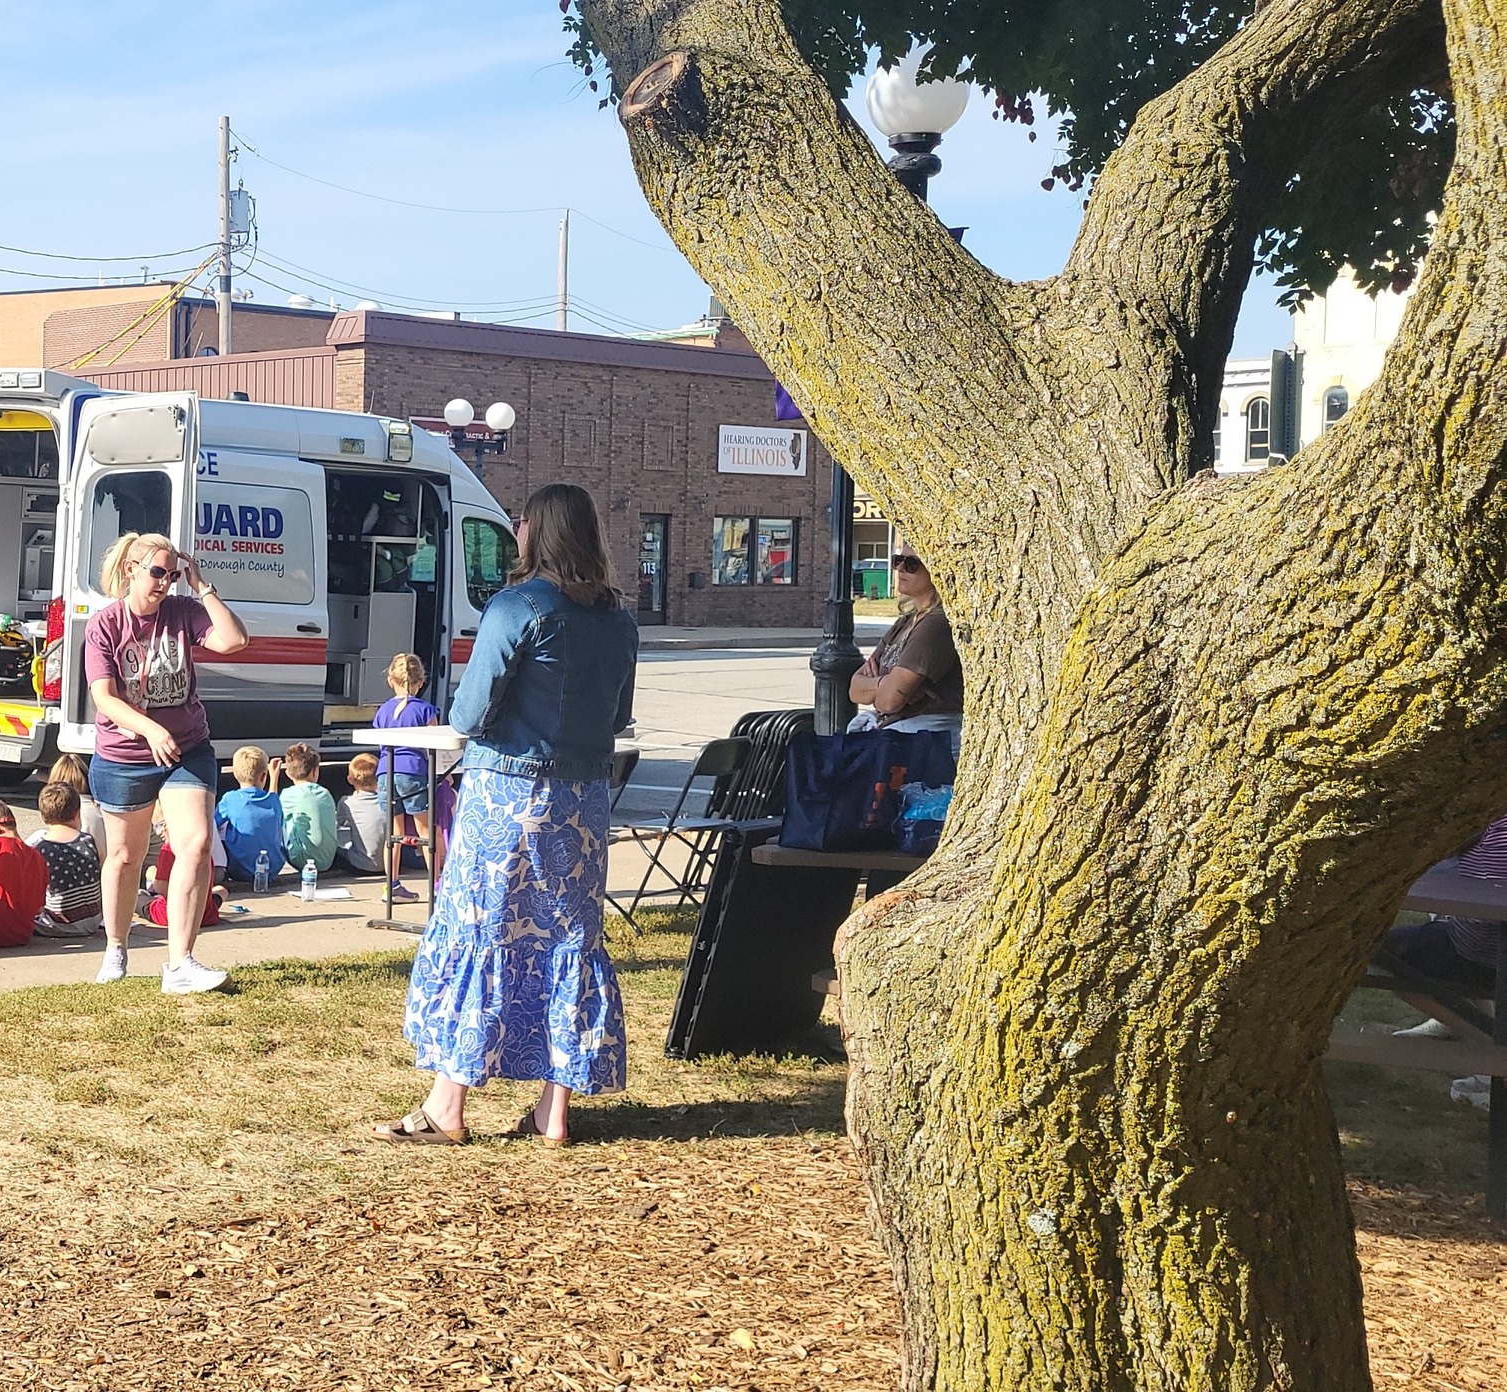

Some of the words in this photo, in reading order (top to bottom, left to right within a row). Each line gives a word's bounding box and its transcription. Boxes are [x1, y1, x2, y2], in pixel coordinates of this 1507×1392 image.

[723, 434, 754, 445] HEARING
[755, 436, 787, 447] DOCTORS
[732, 447, 787, 467] ILLINOIS
[231, 540, 284, 555] SERVICES
[247, 560, 285, 578] County
[643, 562, 657, 575] 113
